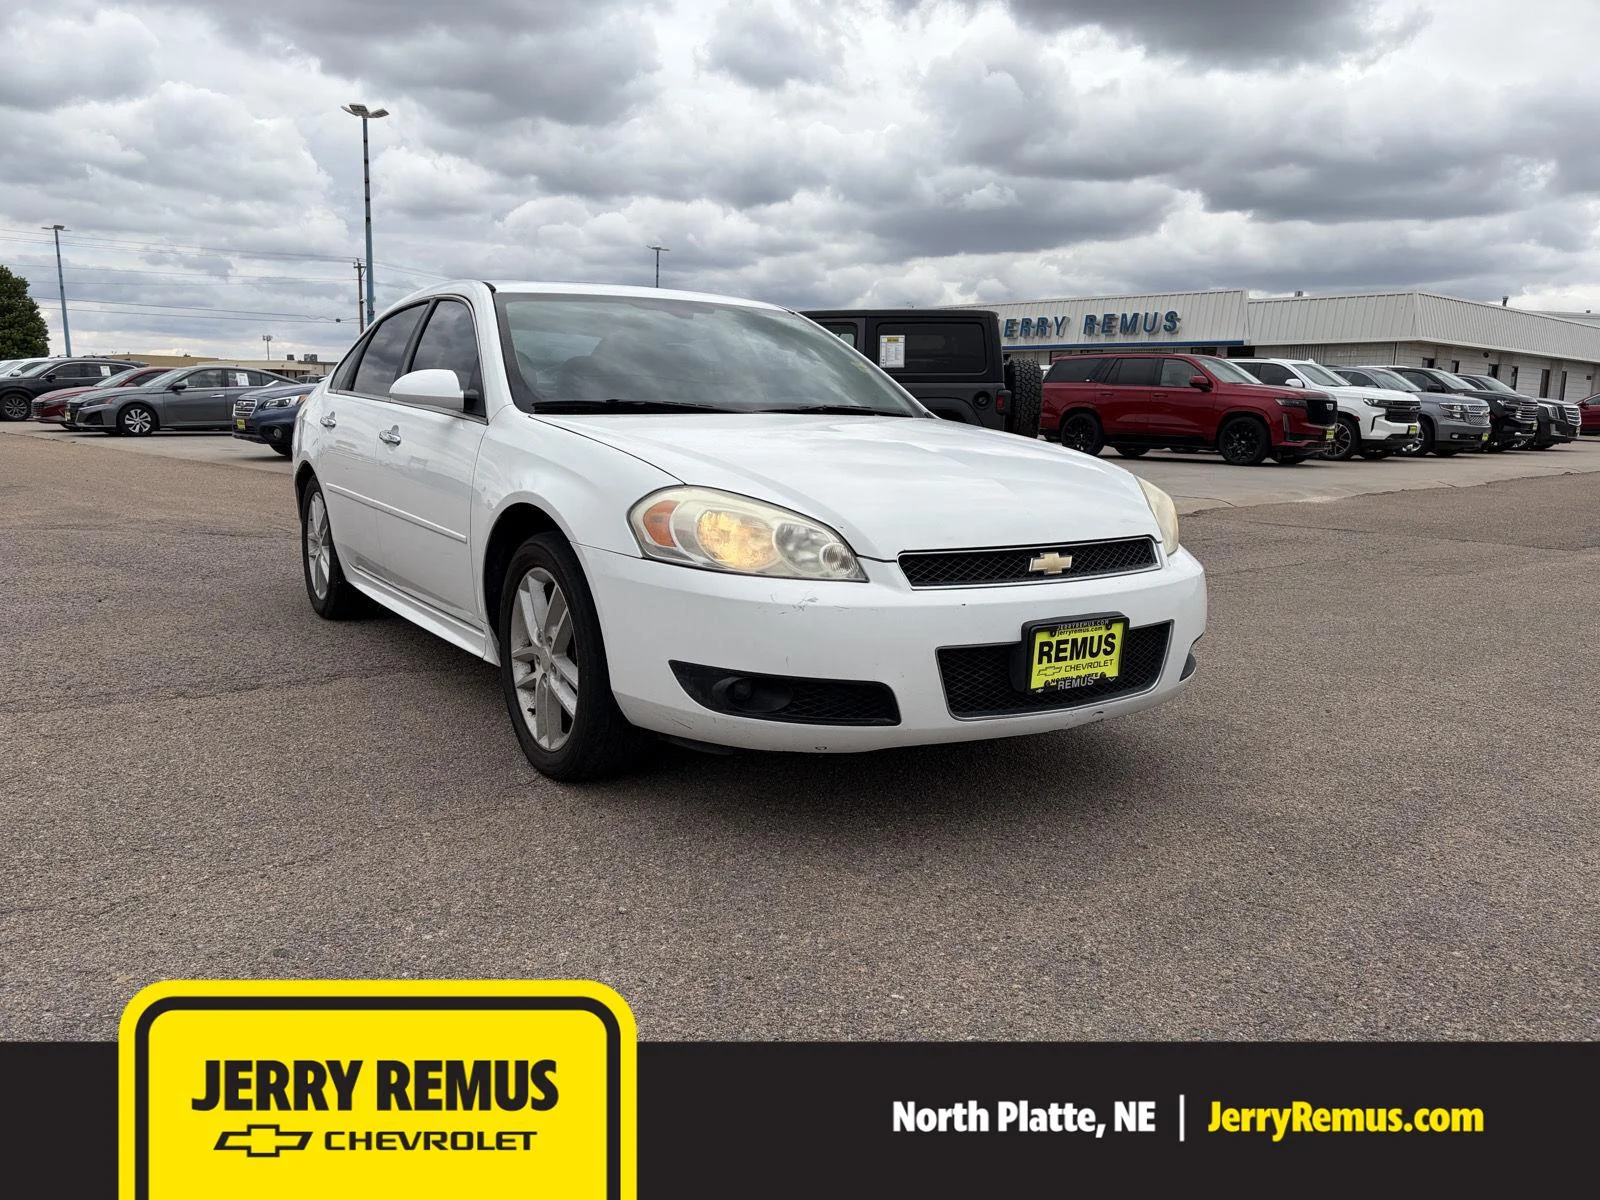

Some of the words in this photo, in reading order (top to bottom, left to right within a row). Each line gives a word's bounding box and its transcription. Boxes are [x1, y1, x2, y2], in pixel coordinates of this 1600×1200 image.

[1003, 316, 1069, 338] ERRY
[1083, 311, 1181, 337] REMUS
[1056, 626, 1103, 637] jerryremus.com
[1038, 633, 1115, 665] REMUS
[1064, 659, 1114, 672] CHEVROLET
[1058, 677, 1094, 690] REMUS
